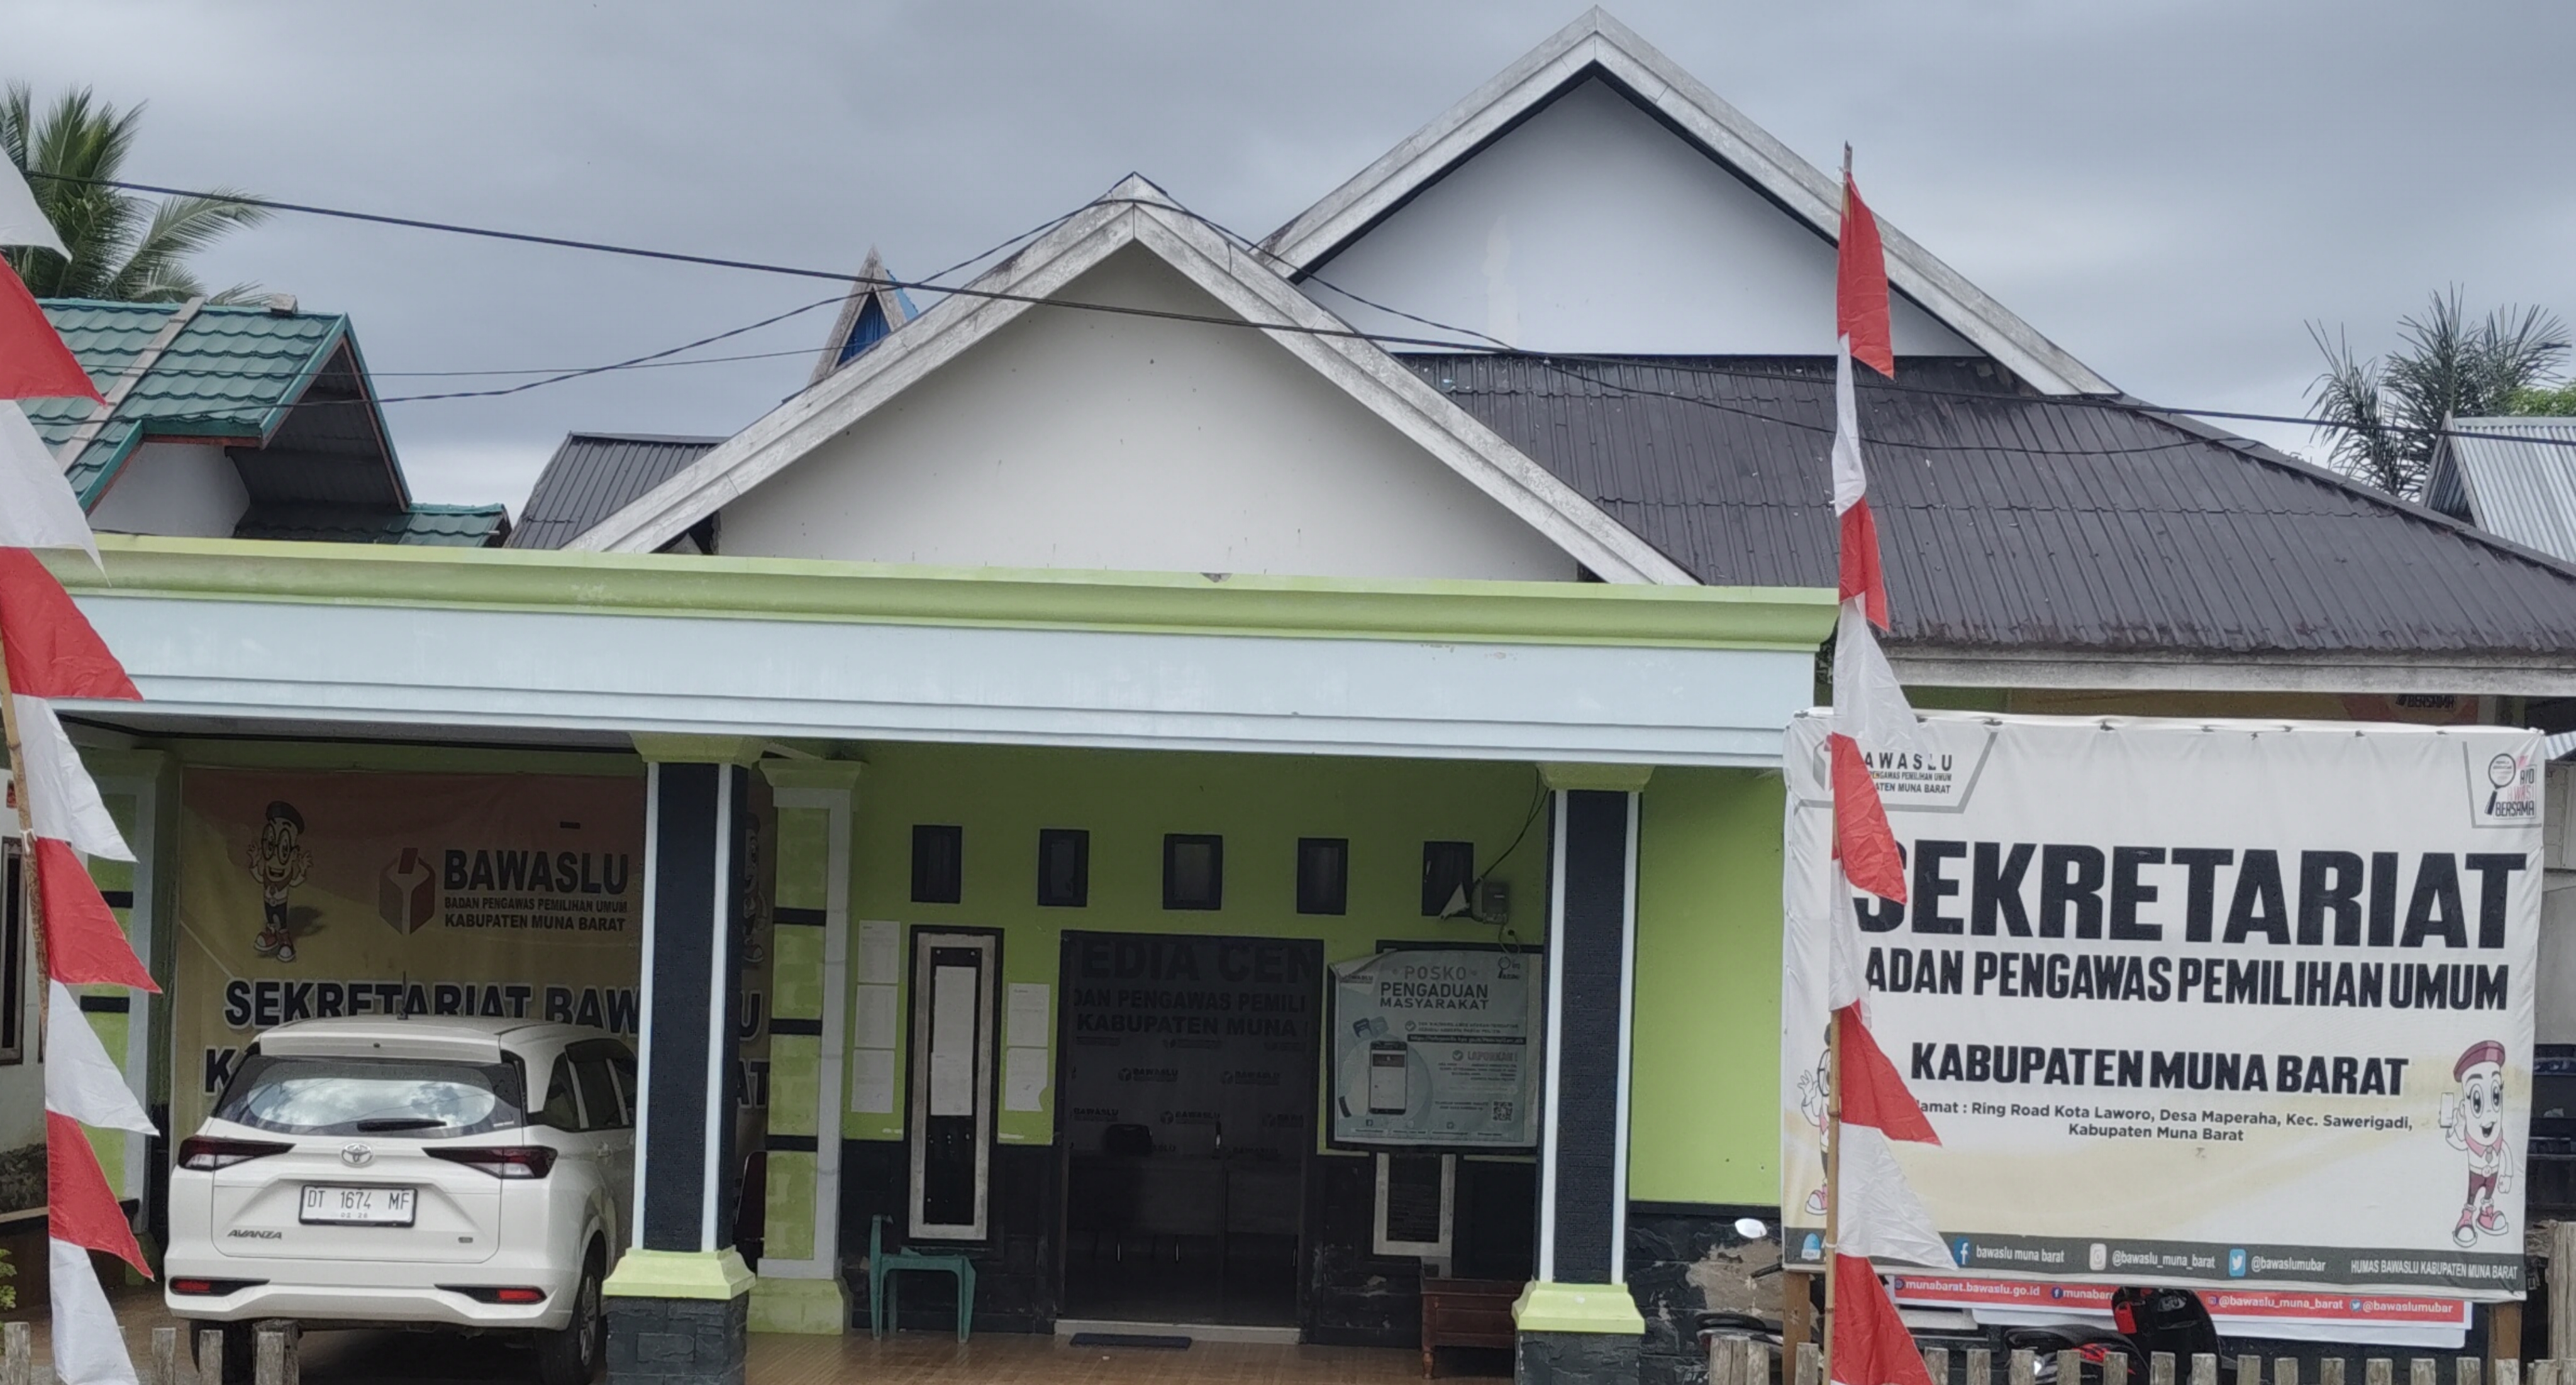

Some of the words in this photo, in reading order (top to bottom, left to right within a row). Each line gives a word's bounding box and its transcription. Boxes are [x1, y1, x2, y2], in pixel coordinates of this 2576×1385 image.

[1865, 752, 1952, 771] AWASLU
[1902, 772, 1933, 780] PEMILIHAN
[1934, 773, 1952, 781] UMUM
[1897, 783, 1921, 792] MUNA
[1924, 784, 1951, 793] BARAT
[2495, 800, 2535, 817] BERSAMA
[443, 849, 628, 895] BAWASLU
[445, 897, 479, 909] BADAN
[482, 897, 535, 910] PENGAWAS
[538, 898, 592, 912] PEMILIHAN
[596, 900, 627, 913] UMUM
[445, 913, 528, 929] KABUPATEN
[531, 915, 574, 930] MUNA
[579, 917, 626, 931] BARAT
[1082, 939, 1199, 981] EDIA
[1404, 966, 1466, 981] POSKO
[1865, 947, 1963, 995] ADAN
[1974, 951, 2172, 1003] PENGAWAS
[2178, 957, 2384, 1008] PEMILIHAN
[2389, 963, 2509, 1011] UMUM
[1380, 982, 1488, 999] PENGADUAN
[1074, 988, 1111, 1007] DAN
[1118, 990, 1231, 1011] PENGAWAS
[1238, 993, 1306, 1013] PEMILI
[1380, 997, 1489, 1010] MASYARAKAT
[1077, 1013, 1218, 1034] KABUPATEN
[1227, 1018, 1297, 1037] MUNA
[1911, 1042, 2143, 1088] KABUPATEN
[2150, 1050, 2268, 1092] MUNA
[2277, 1054, 2409, 1096] BARAT
[1916, 1100, 1958, 1113] amat
[1972, 1101, 2006, 1117] Ring
[2011, 1104, 2049, 1117] Road
[2055, 1105, 2090, 1118] Kota
[2095, 1106, 2155, 1122] Laworo,
[2160, 1109, 2197, 1122] Desa
[2202, 1110, 2281, 1126] Maperaha,
[2286, 1113, 2318, 1126] Kec.
[2323, 1115, 2412, 1131] Sawerigadi,
[2068, 1123, 2151, 1139] Kabupaten
[2157, 1127, 2197, 1139] Muna
[2203, 1128, 2244, 1141] Barat
[308, 1189, 325, 1208] DT
[340, 1191, 372, 1209] 1674
[388, 1192, 409, 1210] MF
[227, 1230, 282, 1239] AVANZA
[1976, 1245, 2012, 1259] bawaslu
[2014, 1250, 2039, 1261] muna
[2041, 1248, 2065, 1262] barat
[2112, 1250, 2216, 1270] @bawaslu_muna_barat
[2251, 1255, 2326, 1272] @bawaslumubar
[2351, 1259, 2379, 1274] HUMAS
[2381, 1261, 2419, 1274] BAWASLU
[2421, 1262, 2466, 1277] KABUPATEN
[2468, 1264, 2490, 1278] MUNA
[2492, 1266, 2518, 1280] BARAT
[1905, 1279, 2040, 1297] munabarat.bawaslu.go.id
[2219, 1297, 2344, 1310] @bawaslu_muna_barat
[2363, 1299, 2453, 1313] @bawaslumubar
